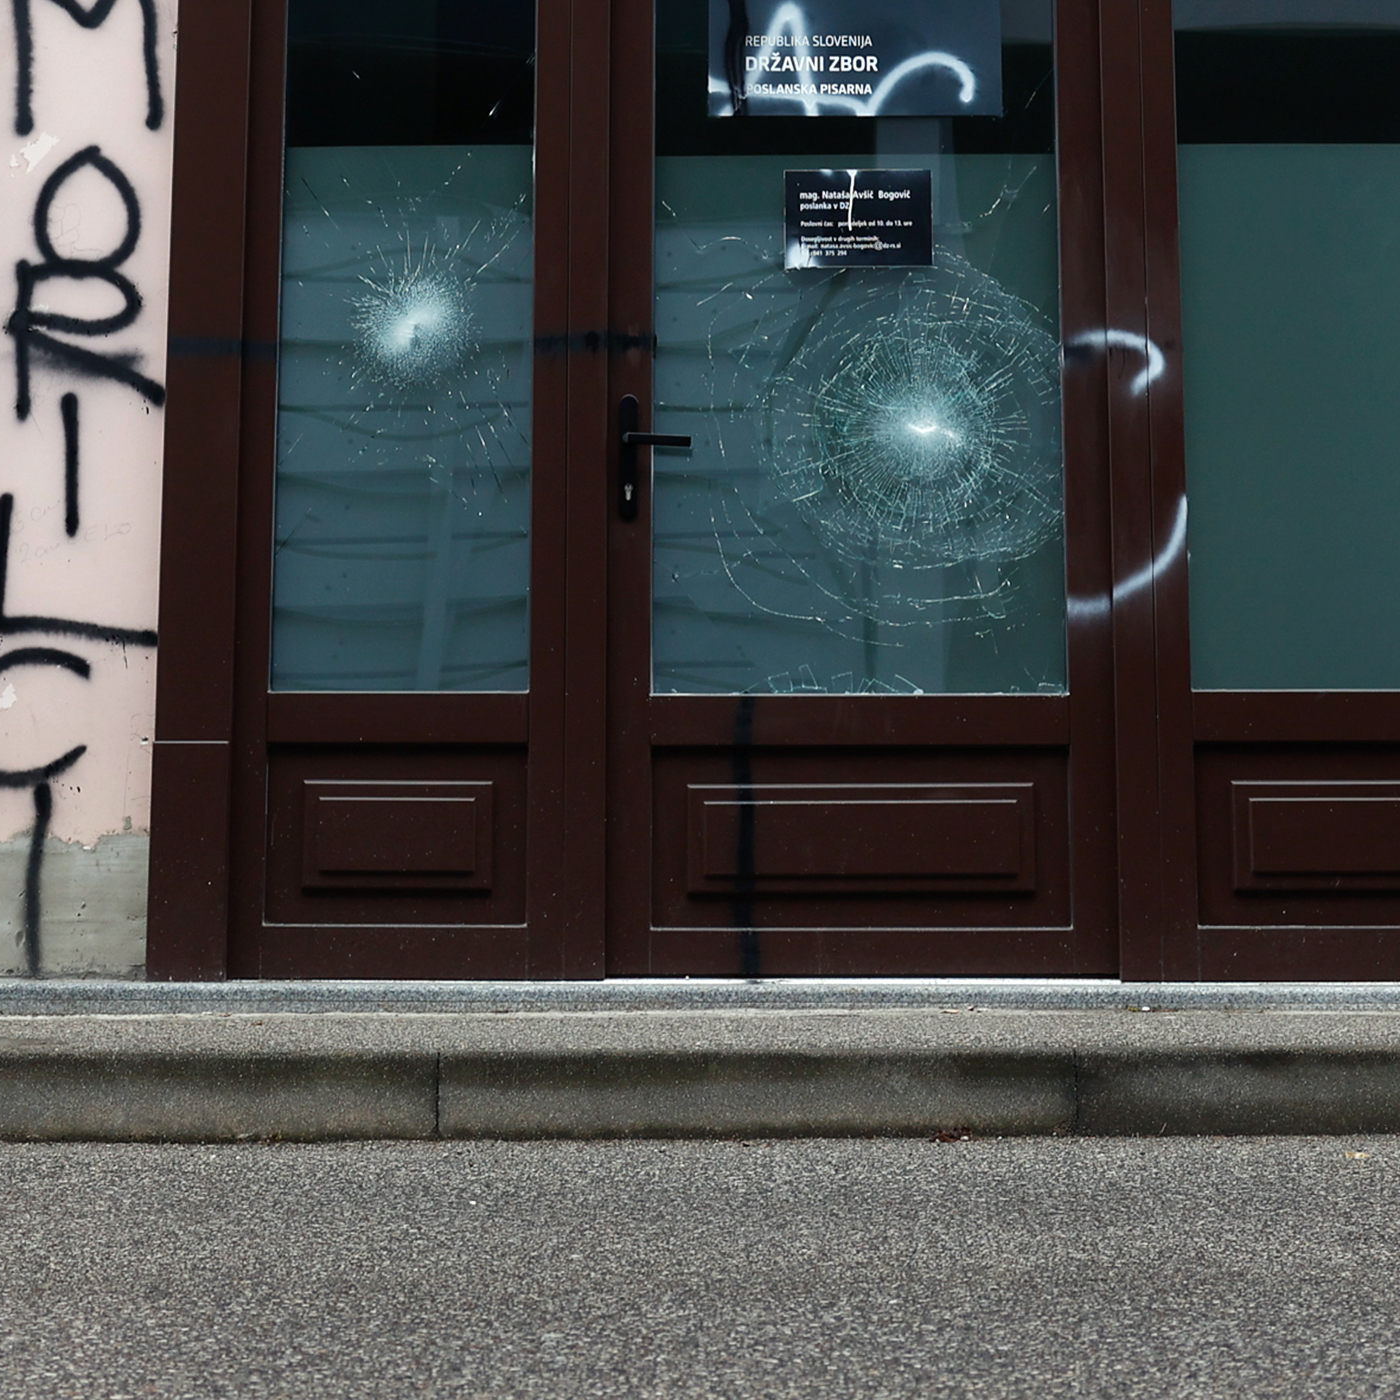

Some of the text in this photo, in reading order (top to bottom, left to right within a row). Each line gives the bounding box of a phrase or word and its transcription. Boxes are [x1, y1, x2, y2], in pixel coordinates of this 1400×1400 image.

[745, 35, 873, 49] REPUBLIKA SLOVENIJA
[745, 52, 879, 72] DRŽAVNI ZBOR
[747, 83, 873, 95] POSLANSKA PISARNA
[799, 189, 911, 201] mag. Nataša Avšič Bogovič
[800, 202, 832, 211] poslanka
